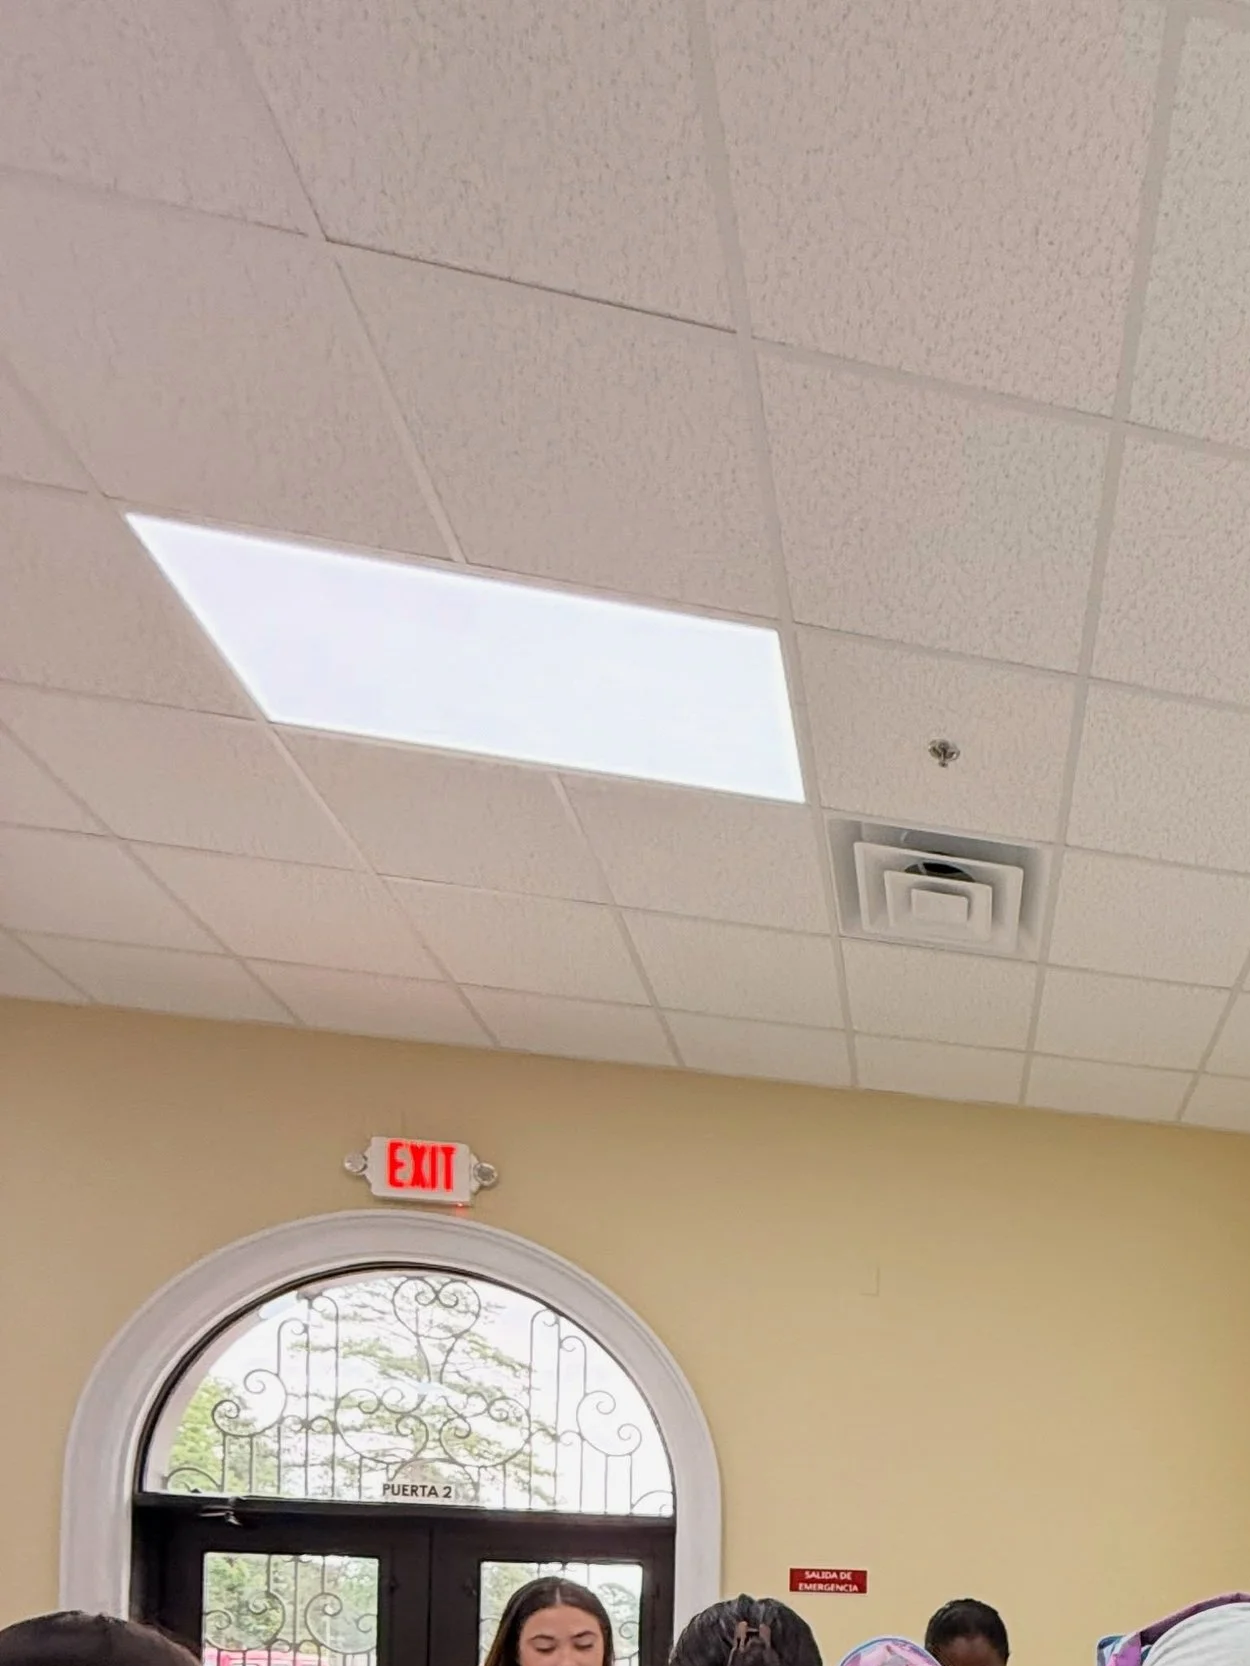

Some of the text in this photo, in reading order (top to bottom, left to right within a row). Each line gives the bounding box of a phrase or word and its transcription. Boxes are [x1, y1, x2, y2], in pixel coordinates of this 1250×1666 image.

[387, 1140, 458, 1191] EXIT
[382, 1483, 453, 1499] PUERTA 2
[804, 1570, 853, 1580] SALIDA DE
[798, 1583, 859, 1592] EMERGENCIA
